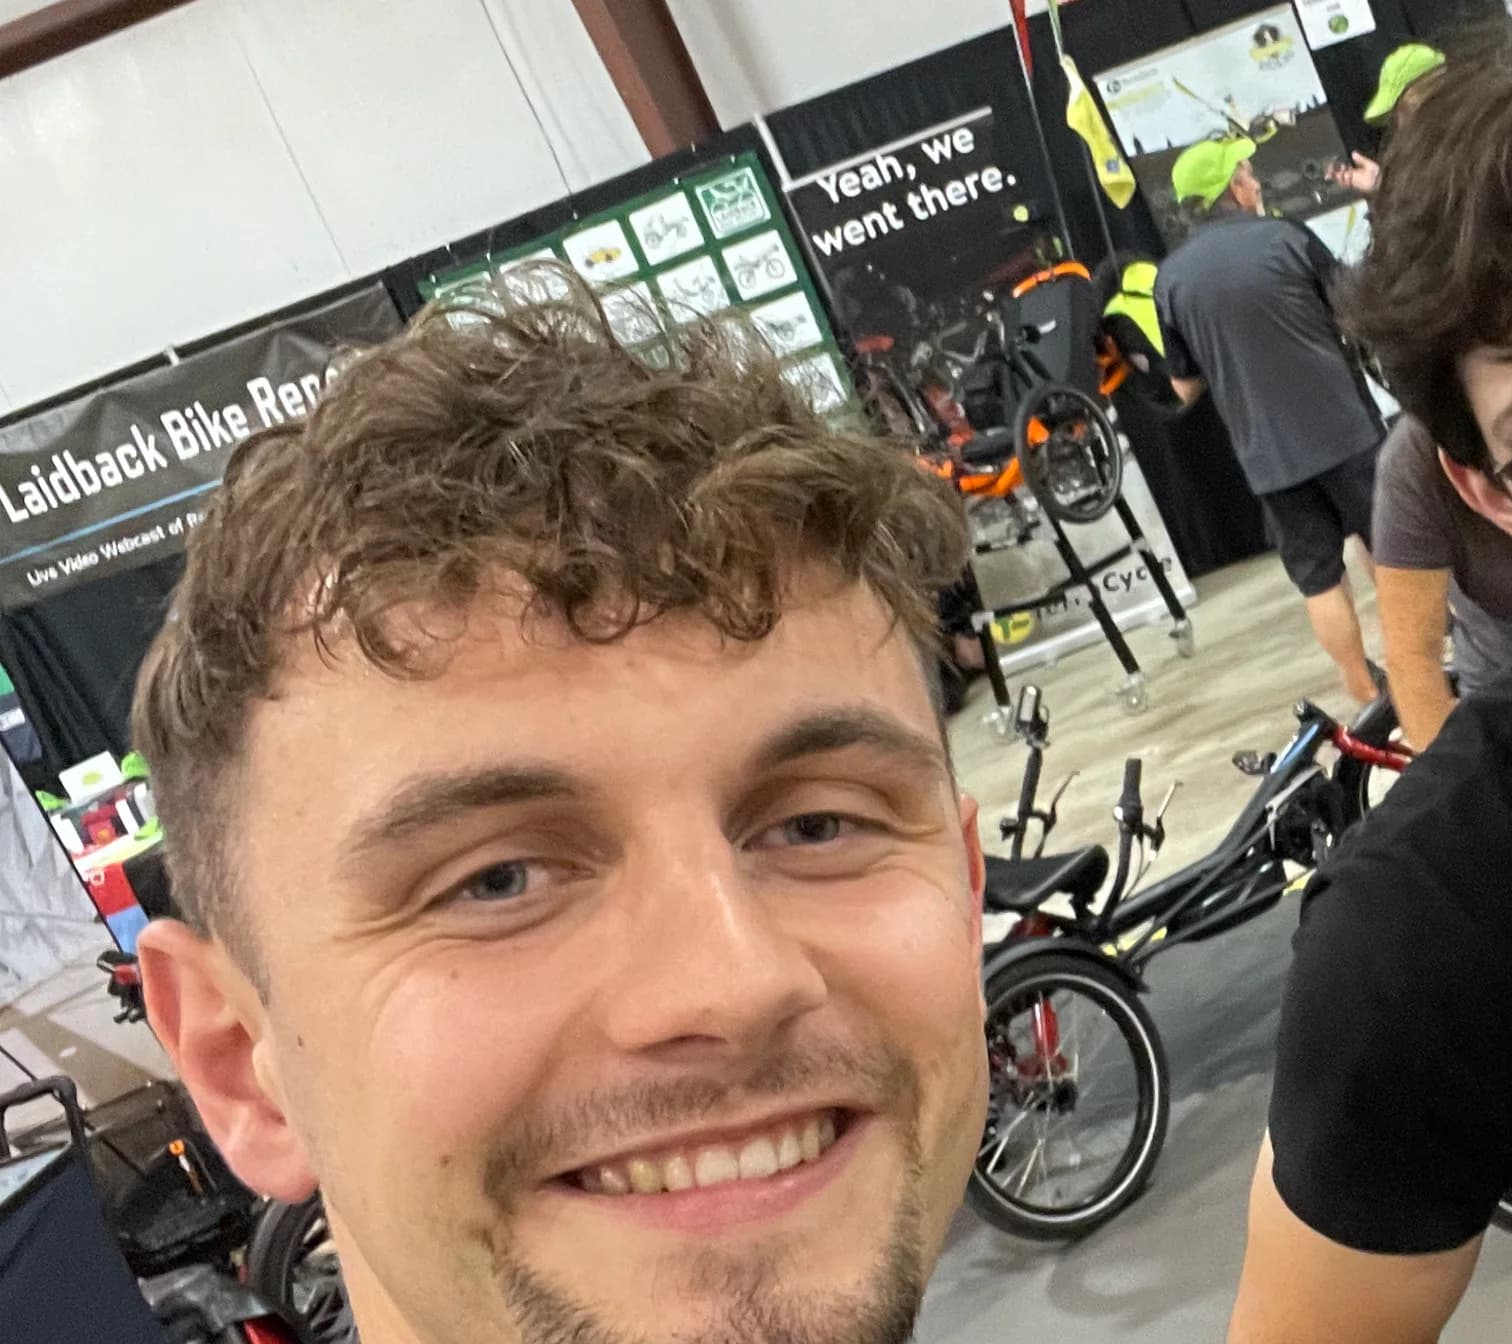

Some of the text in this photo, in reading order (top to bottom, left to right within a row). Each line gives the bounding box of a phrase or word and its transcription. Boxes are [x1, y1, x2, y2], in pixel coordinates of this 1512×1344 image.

[816, 127, 976, 204] Yeah, we
[812, 201, 905, 257] went
[906, 166, 1017, 221] there.
[0, 425, 169, 524] Laidback
[160, 399, 250, 460] Bike
[58, 550, 100, 577] Video
[99, 524, 166, 561] Webcast
